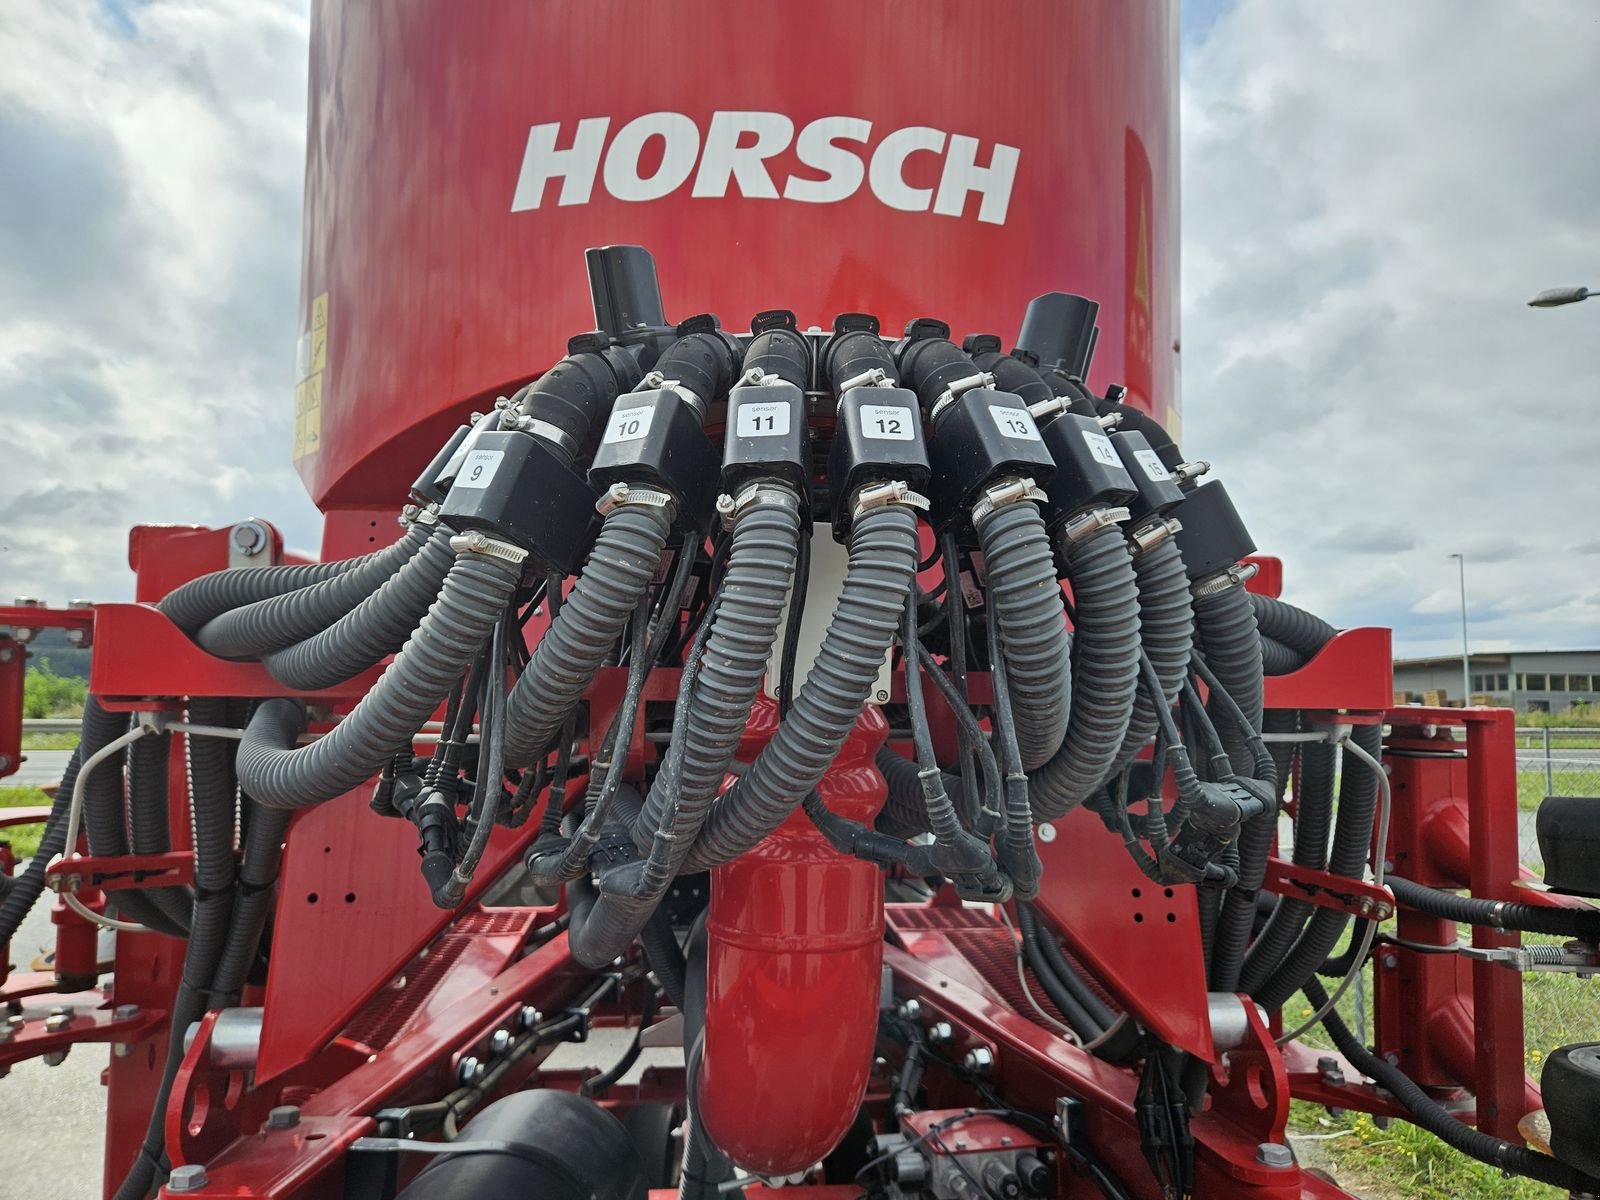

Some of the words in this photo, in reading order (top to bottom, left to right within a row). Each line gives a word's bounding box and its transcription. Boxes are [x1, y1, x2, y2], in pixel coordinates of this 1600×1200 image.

[510, 110, 1021, 226] HORSCH
[622, 410, 644, 419] sensor
[618, 420, 640, 437] 10
[752, 415, 774, 431] 11
[875, 419, 902, 434] 12
[1006, 419, 1028, 435] 13
[1097, 445, 1114, 462] 14
[470, 465, 483, 482] 9
[1148, 462, 1163, 476] 15
